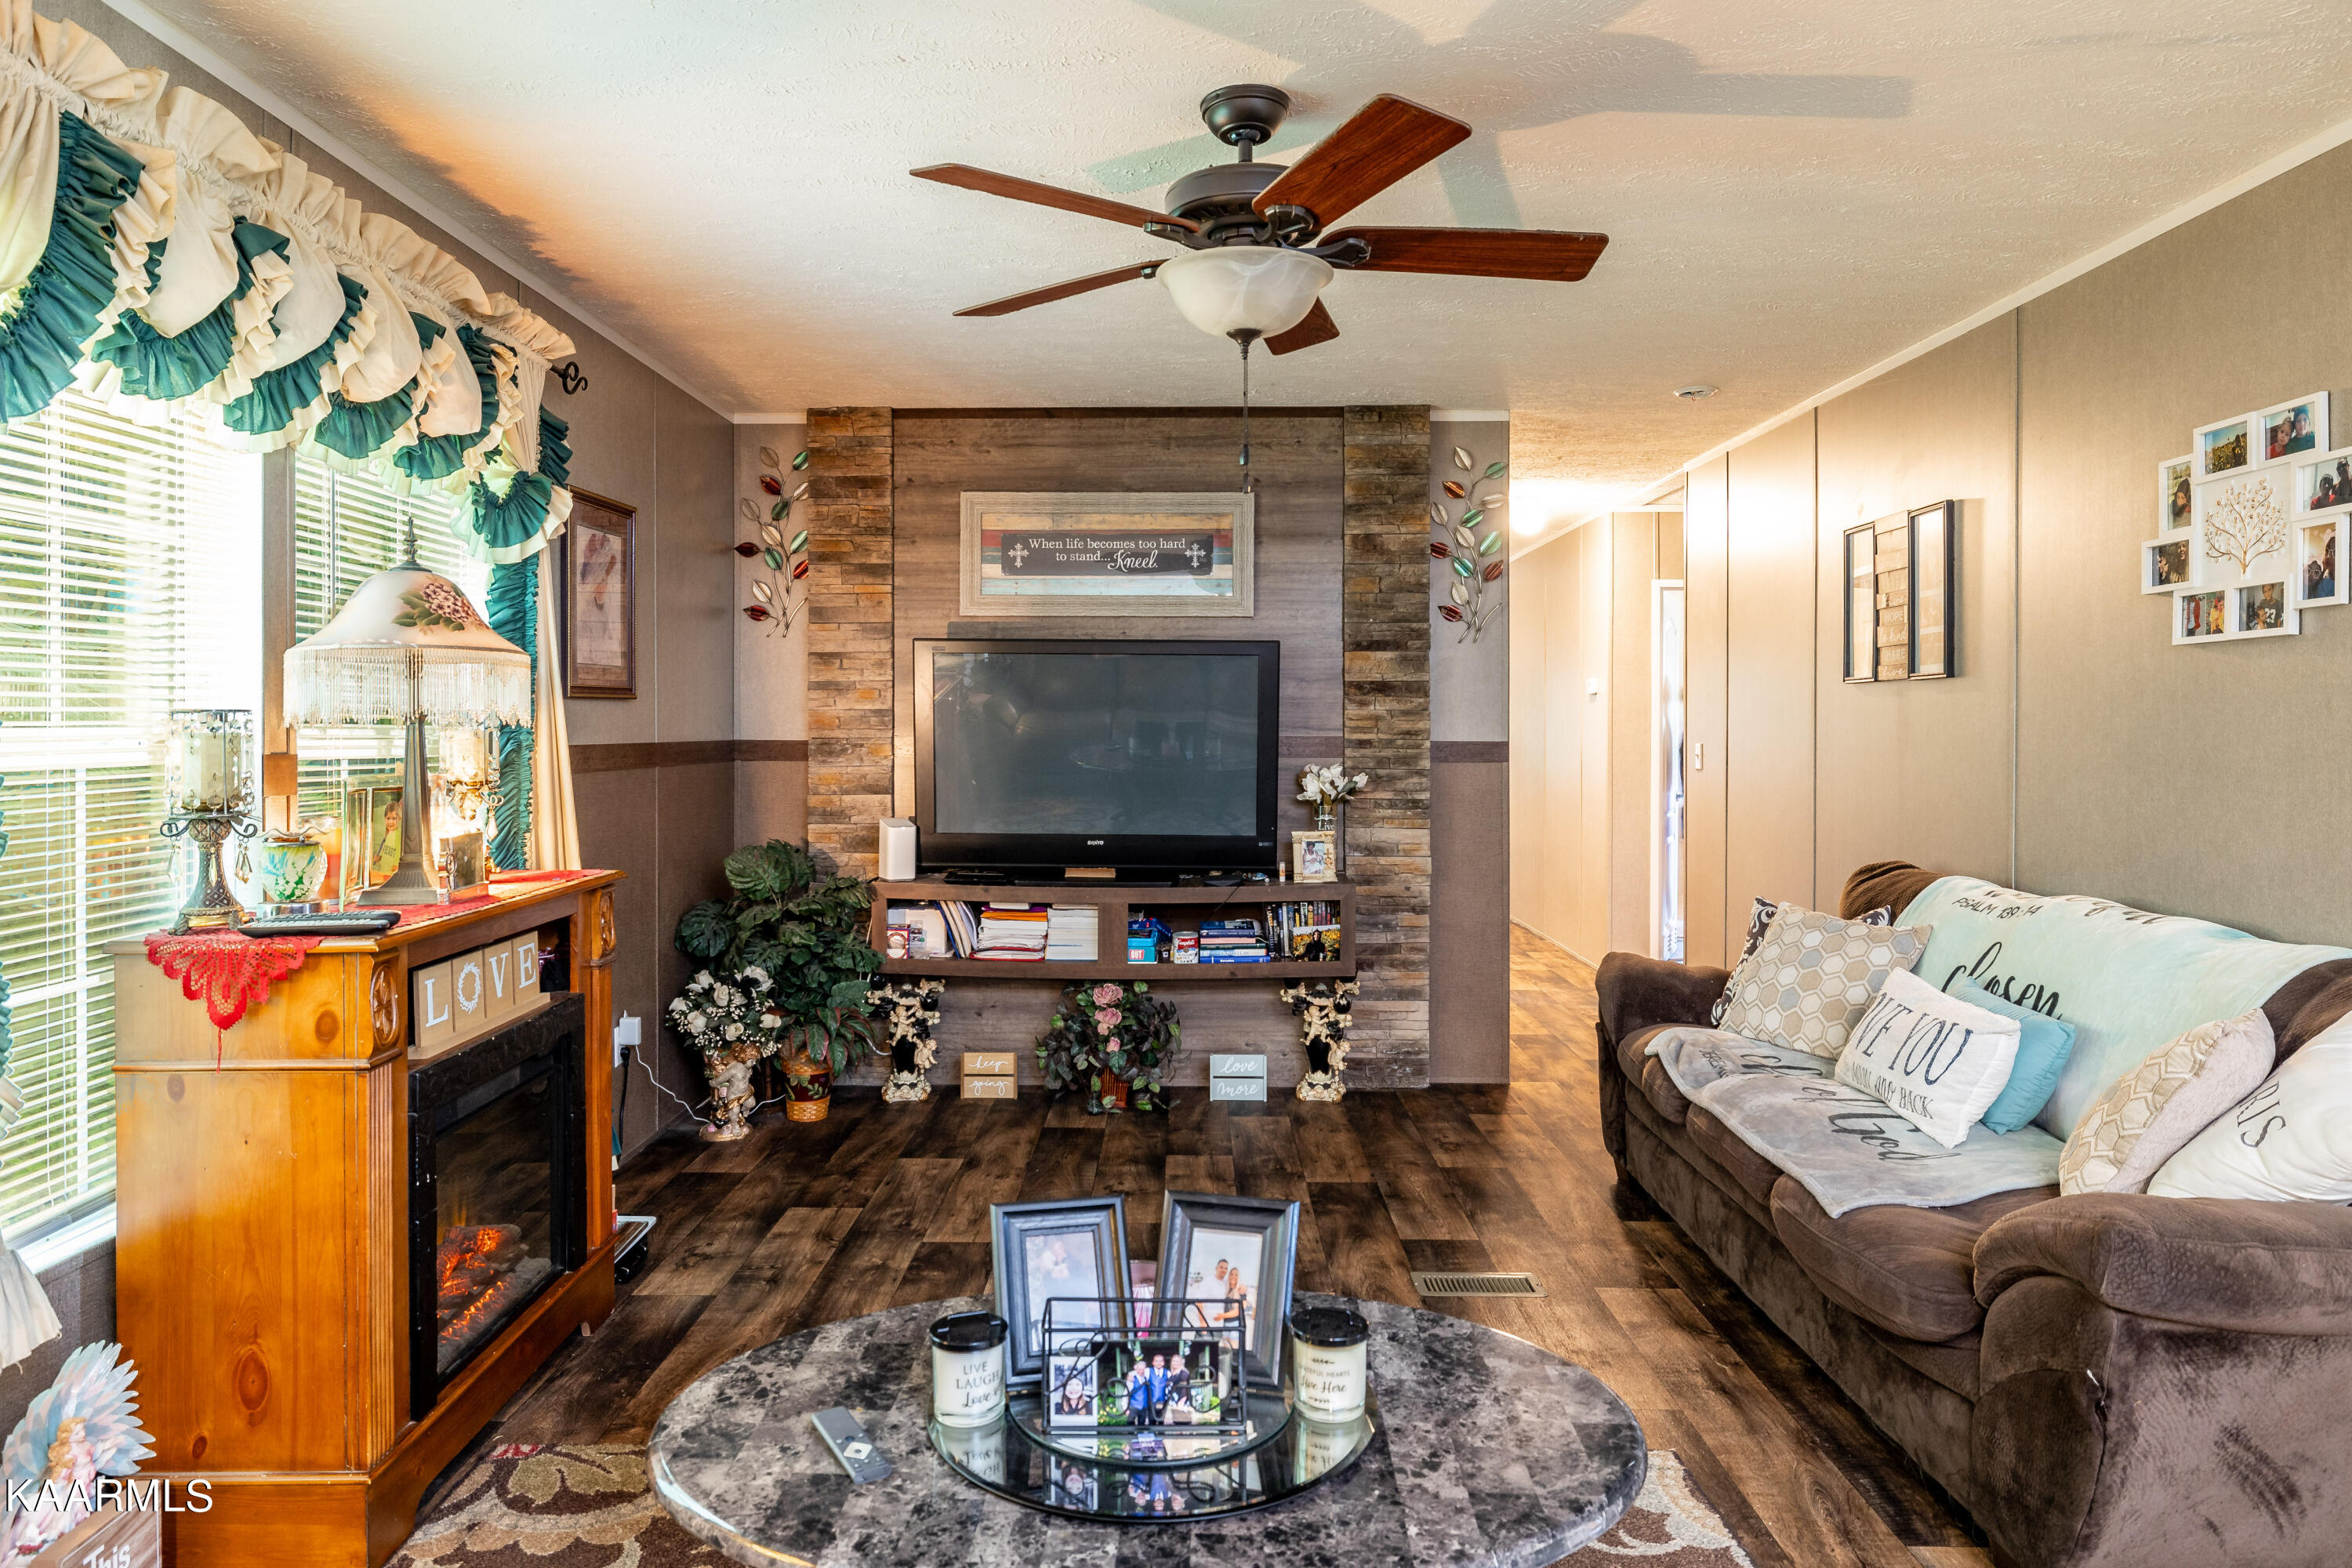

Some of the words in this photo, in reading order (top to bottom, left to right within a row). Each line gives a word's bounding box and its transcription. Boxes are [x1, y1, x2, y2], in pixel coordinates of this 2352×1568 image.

[1029, 538, 1063, 549] When
[1065, 538, 1084, 549] life
[1087, 538, 1135, 549] becomes
[1138, 539, 1158, 549] too
[1160, 538, 1186, 549] hard
[1055, 552, 1067, 561] to
[1069, 550, 1111, 561] stand...
[1107, 549, 1159, 572] Kneel.
[1884, 610, 1904, 622] HOPE
[1883, 648, 1906, 660] HARE
[1951, 896, 1998, 916] PSALM
[1888, 1012, 1974, 1086] YOU
[968, 1055, 1009, 1073] keep
[1220, 1056, 1258, 1073] love
[969, 1079, 1010, 1096] going
[1217, 1082, 1260, 1097] more
[1898, 1086, 1934, 1120] BACK
[964, 1361, 988, 1375] LIVE
[956, 1370, 999, 1389] LAUGH
[961, 1392, 992, 1408] Love
